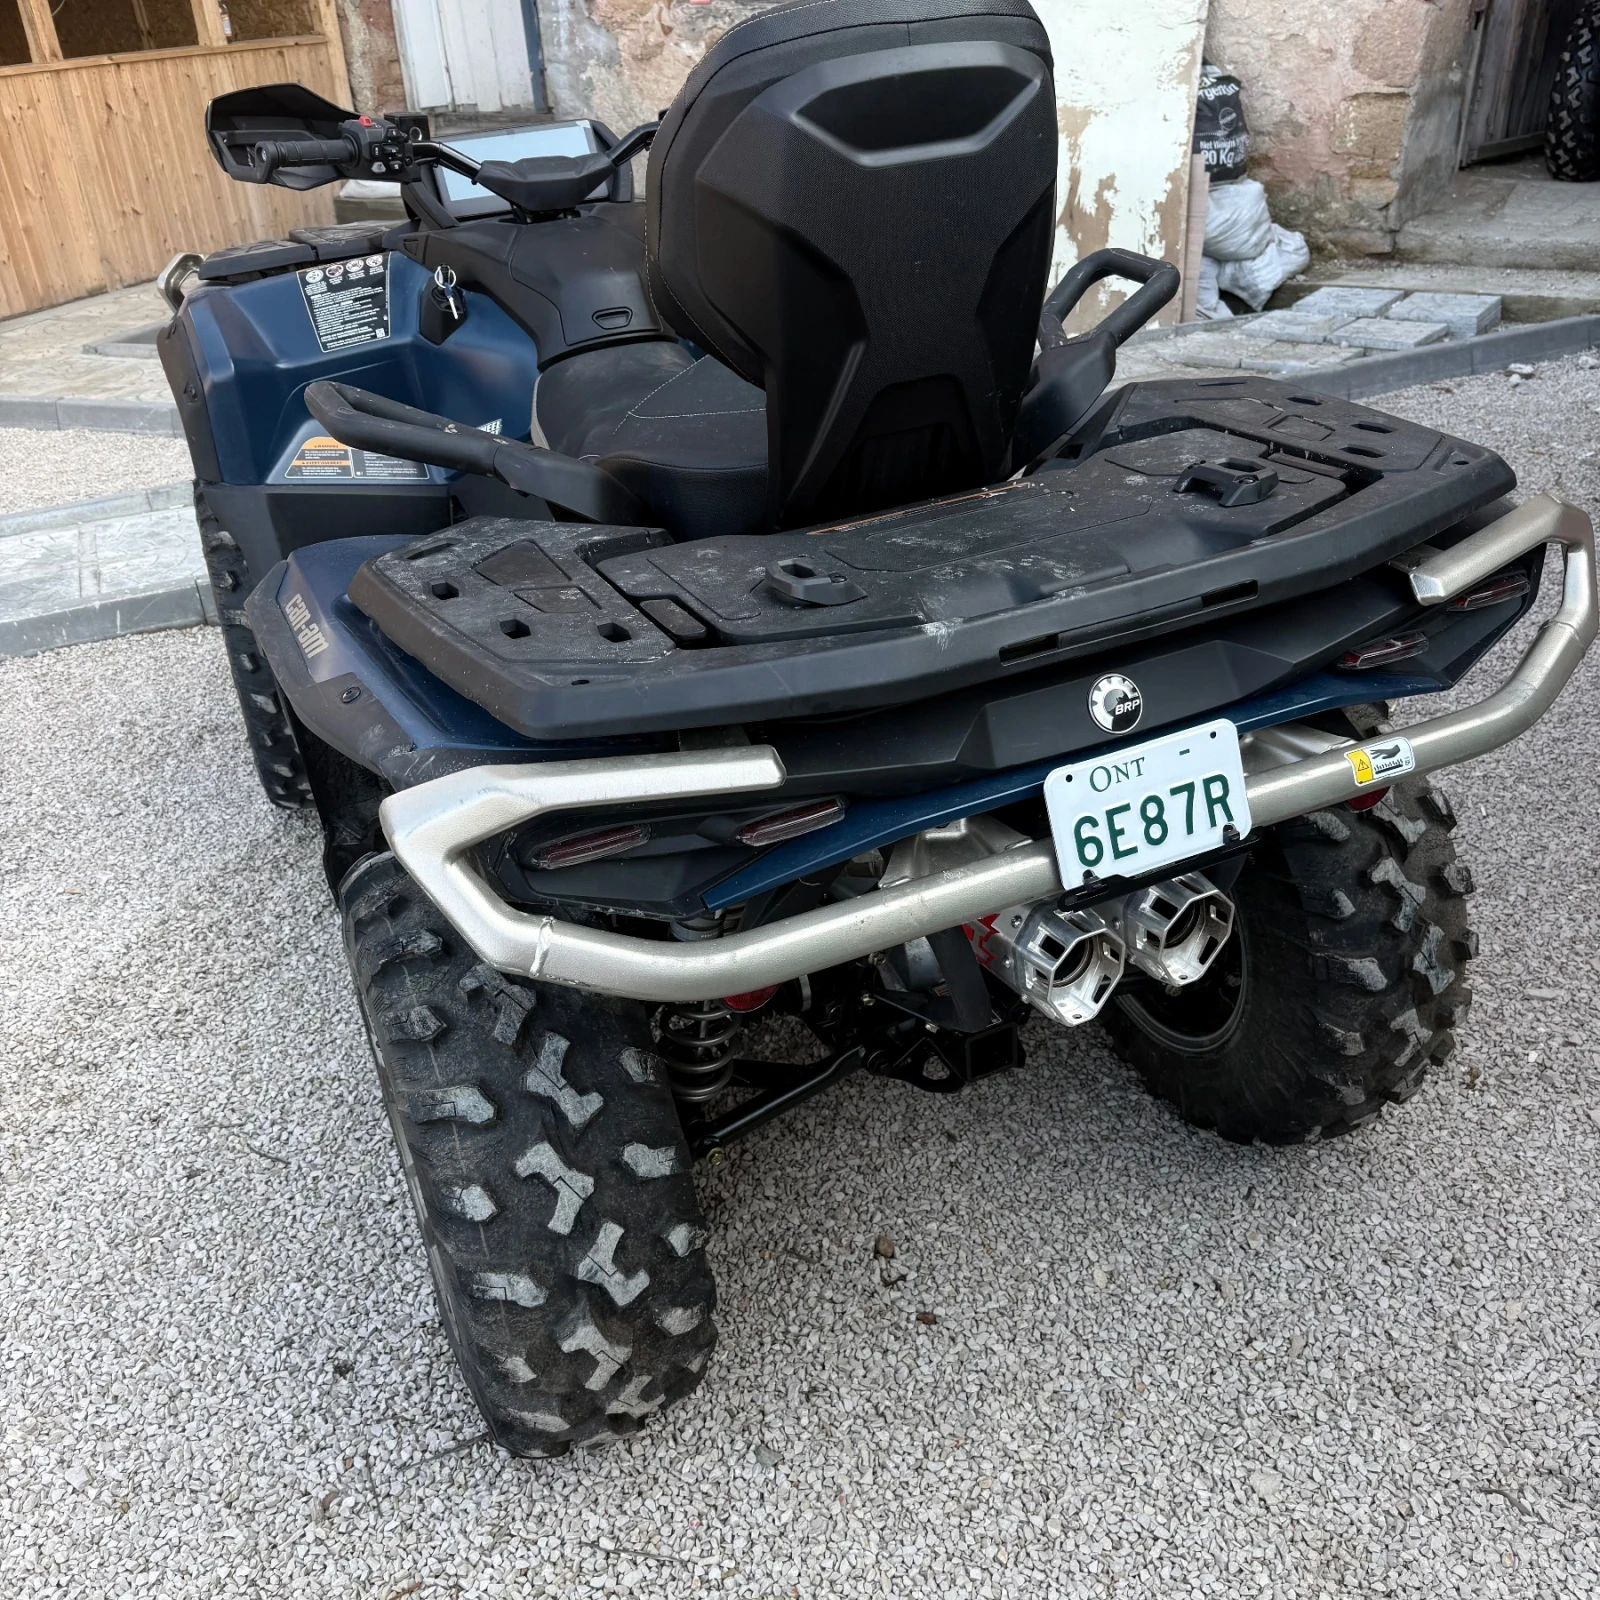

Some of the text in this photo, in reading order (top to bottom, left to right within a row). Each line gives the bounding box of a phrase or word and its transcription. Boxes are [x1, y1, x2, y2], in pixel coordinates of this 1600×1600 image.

[1219, 148, 1235, 168] Kg
[1114, 698, 1141, 716] BRP
[1073, 773, 1234, 868] 6E87R
